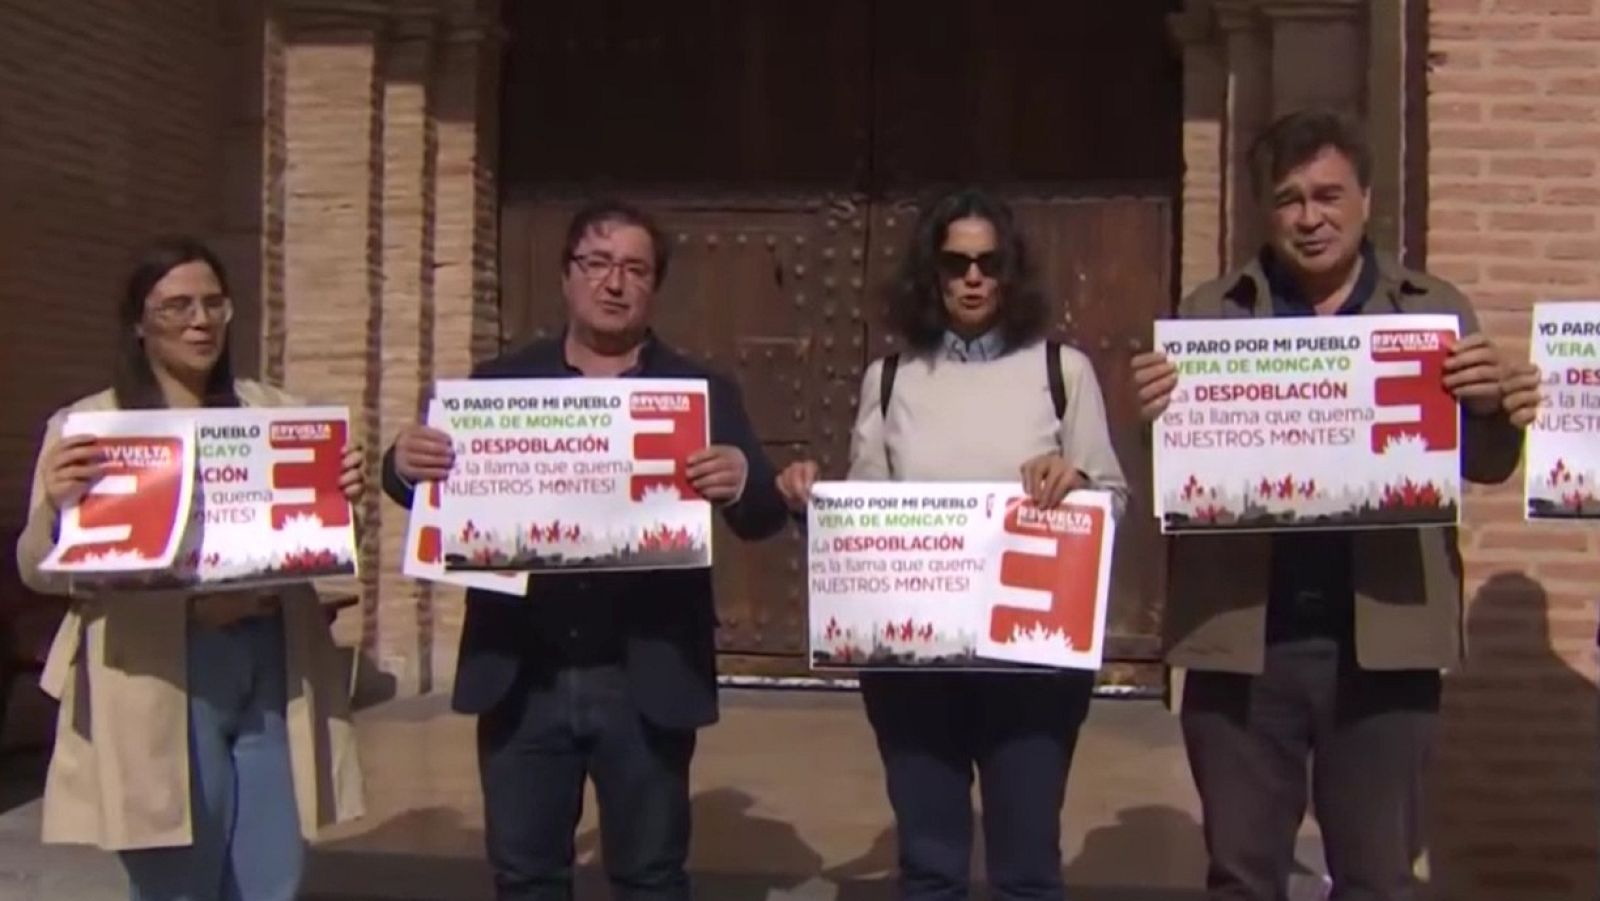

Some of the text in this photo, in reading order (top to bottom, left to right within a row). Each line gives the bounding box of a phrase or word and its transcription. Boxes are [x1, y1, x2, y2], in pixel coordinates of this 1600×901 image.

[1538, 322, 1558, 336] YO
[1162, 335, 1361, 354] YO PARO POR MI PUEBLO
[1545, 342, 1597, 357] VERA
[1227, 358, 1250, 373] DE
[1256, 356, 1351, 373] MONCAYO
[1195, 378, 1347, 402] DESPOBLACIÓN
[442, 397, 460, 411] YO
[463, 397, 504, 411] PARO
[508, 396, 538, 410] POR
[542, 395, 559, 409] MI
[563, 395, 622, 410] PUEBLO
[451, 413, 612, 430] VERA DE MONCAYO
[1163, 406, 1375, 426] es la llama que quema
[200, 425, 261, 440] PUEBLO
[1164, 427, 1355, 449] NUESTROS MONTES!
[471, 434, 609, 454] DESPOBLACIÓN
[466, 460, 480, 475] la
[484, 459, 530, 475] llama
[535, 461, 568, 476] que
[573, 460, 634, 475] quema
[444, 478, 616, 497] NUESTROS MONTES!
[211, 491, 273, 505] quema
[826, 496, 865, 510] PARO
[868, 496, 898, 510] POR
[901, 497, 918, 509] MI
[922, 496, 978, 510] PUEBLO
[817, 513, 968, 528] VERA DE MONCAYO
[833, 533, 965, 552] DESPOBLACIÓN
[828, 558, 841, 573] la
[891, 559, 924, 574] que
[811, 576, 970, 593] NUESTROS MONTES!
